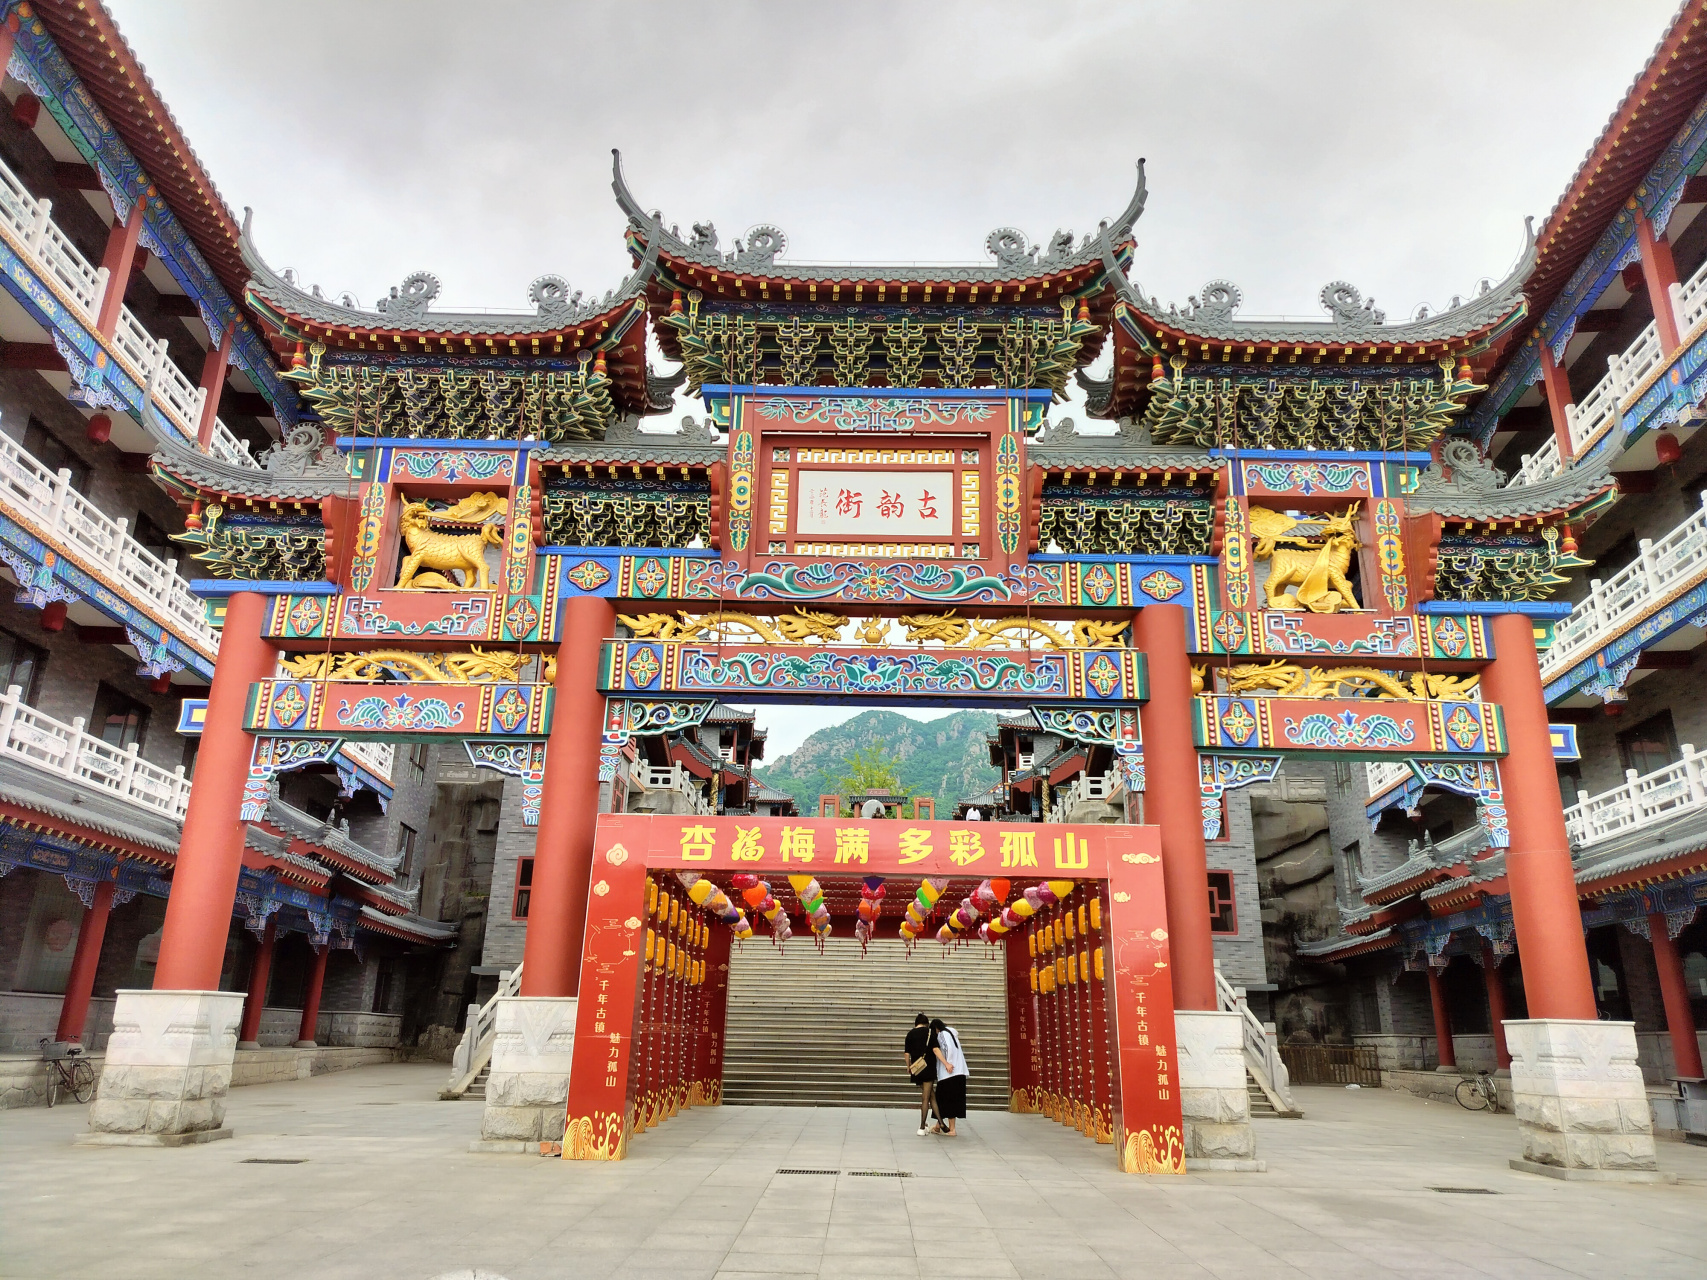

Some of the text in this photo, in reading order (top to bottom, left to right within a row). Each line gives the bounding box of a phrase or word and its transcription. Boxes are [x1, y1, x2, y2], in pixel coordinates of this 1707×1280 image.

[898, 827, 1089, 869] 多彩孤山
[594, 980, 610, 1033] 千年古镇
[1135, 992, 1150, 1046] 千年古镇
[605, 1032, 621, 1087] 魅力孤山
[1155, 1045, 1170, 1100] 魅力孤山
